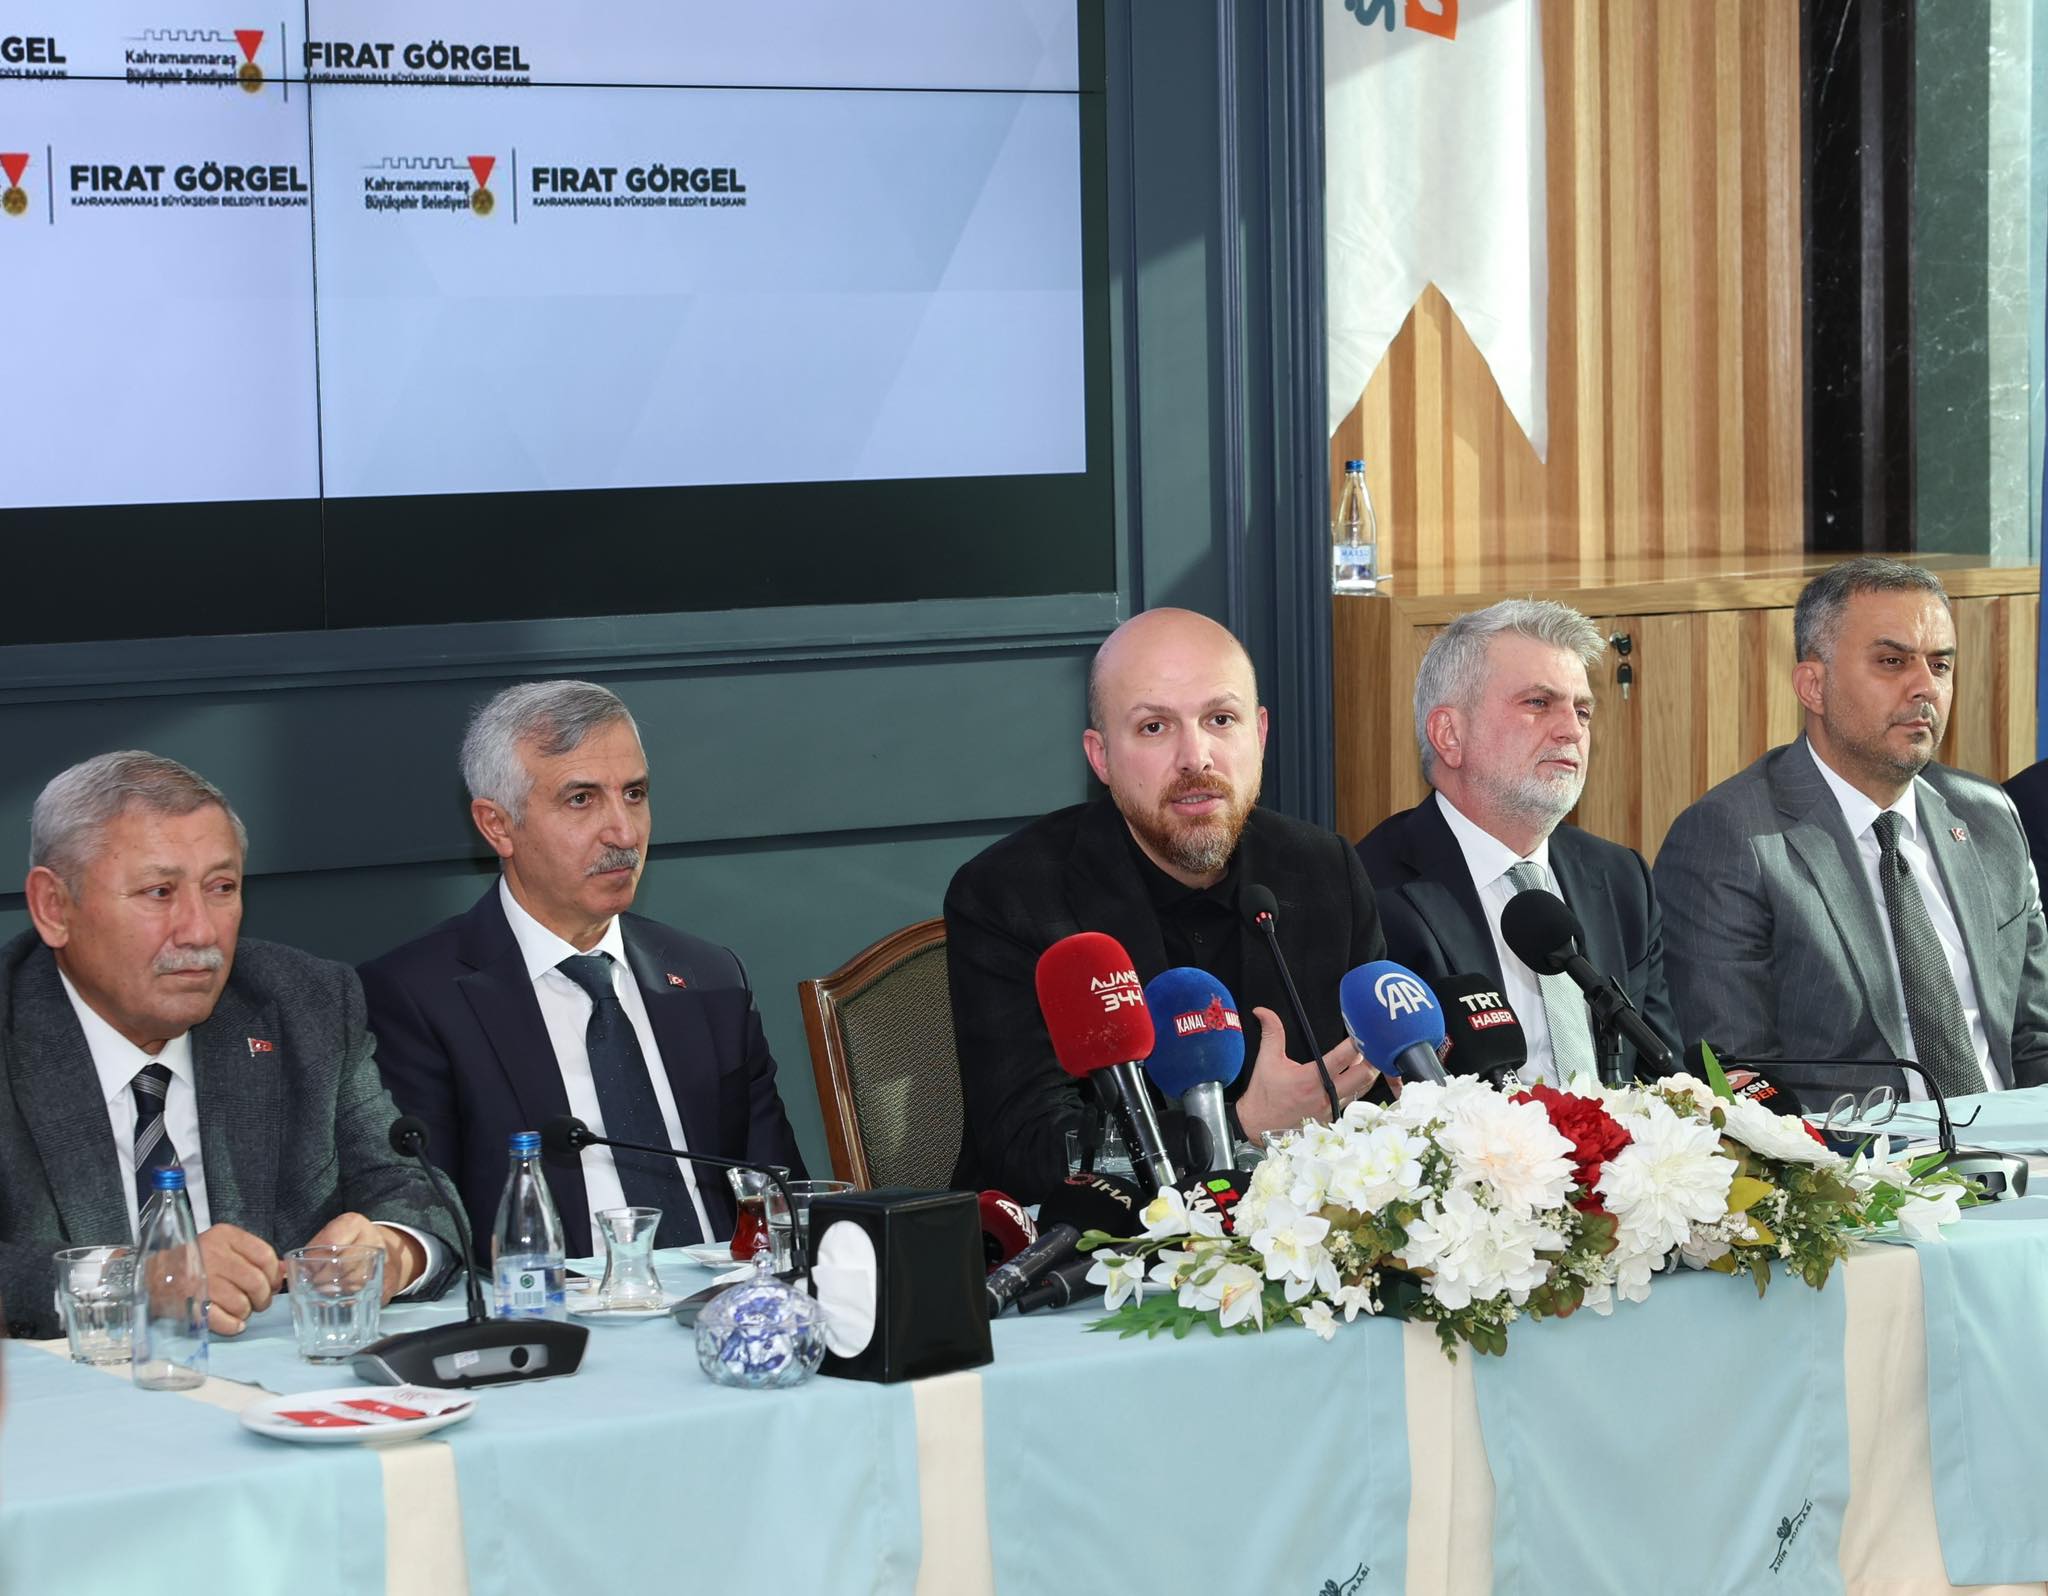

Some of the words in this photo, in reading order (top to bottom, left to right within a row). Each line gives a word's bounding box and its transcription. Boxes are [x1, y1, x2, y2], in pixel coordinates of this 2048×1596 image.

[0, 36, 66, 64] GEL
[125, 50, 236, 67] Kahramanmaraş
[303, 42, 394, 68] FIRAT
[403, 40, 530, 71] GÖRGEL
[70, 165, 165, 192] FIRAT
[173, 161, 308, 193] GÖRGEL
[364, 176, 470, 195] Kahramanmaraş
[532, 167, 618, 192] FIRAT
[625, 163, 746, 193] GÖRGEL
[1090, 970, 1139, 991] AJANS
[1101, 989, 1144, 1013] 344
[1385, 981, 1435, 1021] AA
[1459, 991, 1504, 1012] TRT
[1176, 1014, 1206, 1034] KANAL
[1471, 1011, 1514, 1028] HABER
[1735, 1079, 1770, 1098] KSU
[1748, 1086, 1779, 1102] BER
